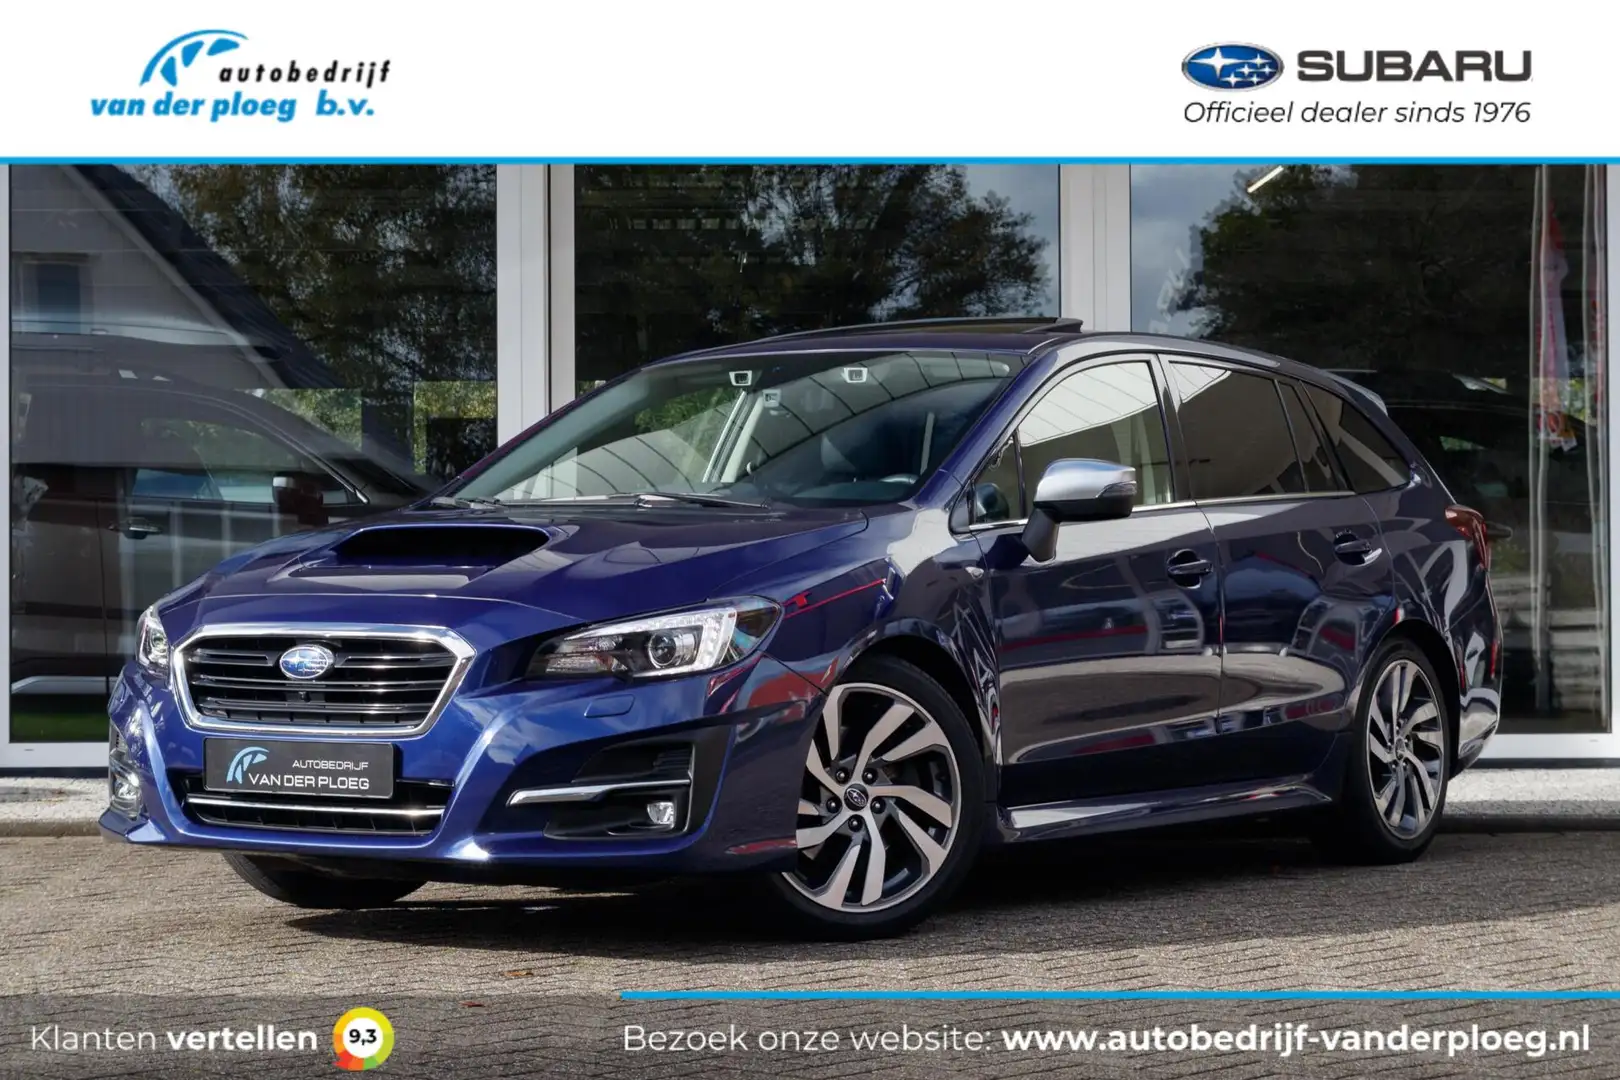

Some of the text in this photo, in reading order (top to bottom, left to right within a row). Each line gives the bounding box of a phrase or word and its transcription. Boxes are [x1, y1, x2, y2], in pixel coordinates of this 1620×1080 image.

[292, 760, 369, 771] AUTOBEDRIJF
[248, 773, 370, 790] VAN DER PLOEG
